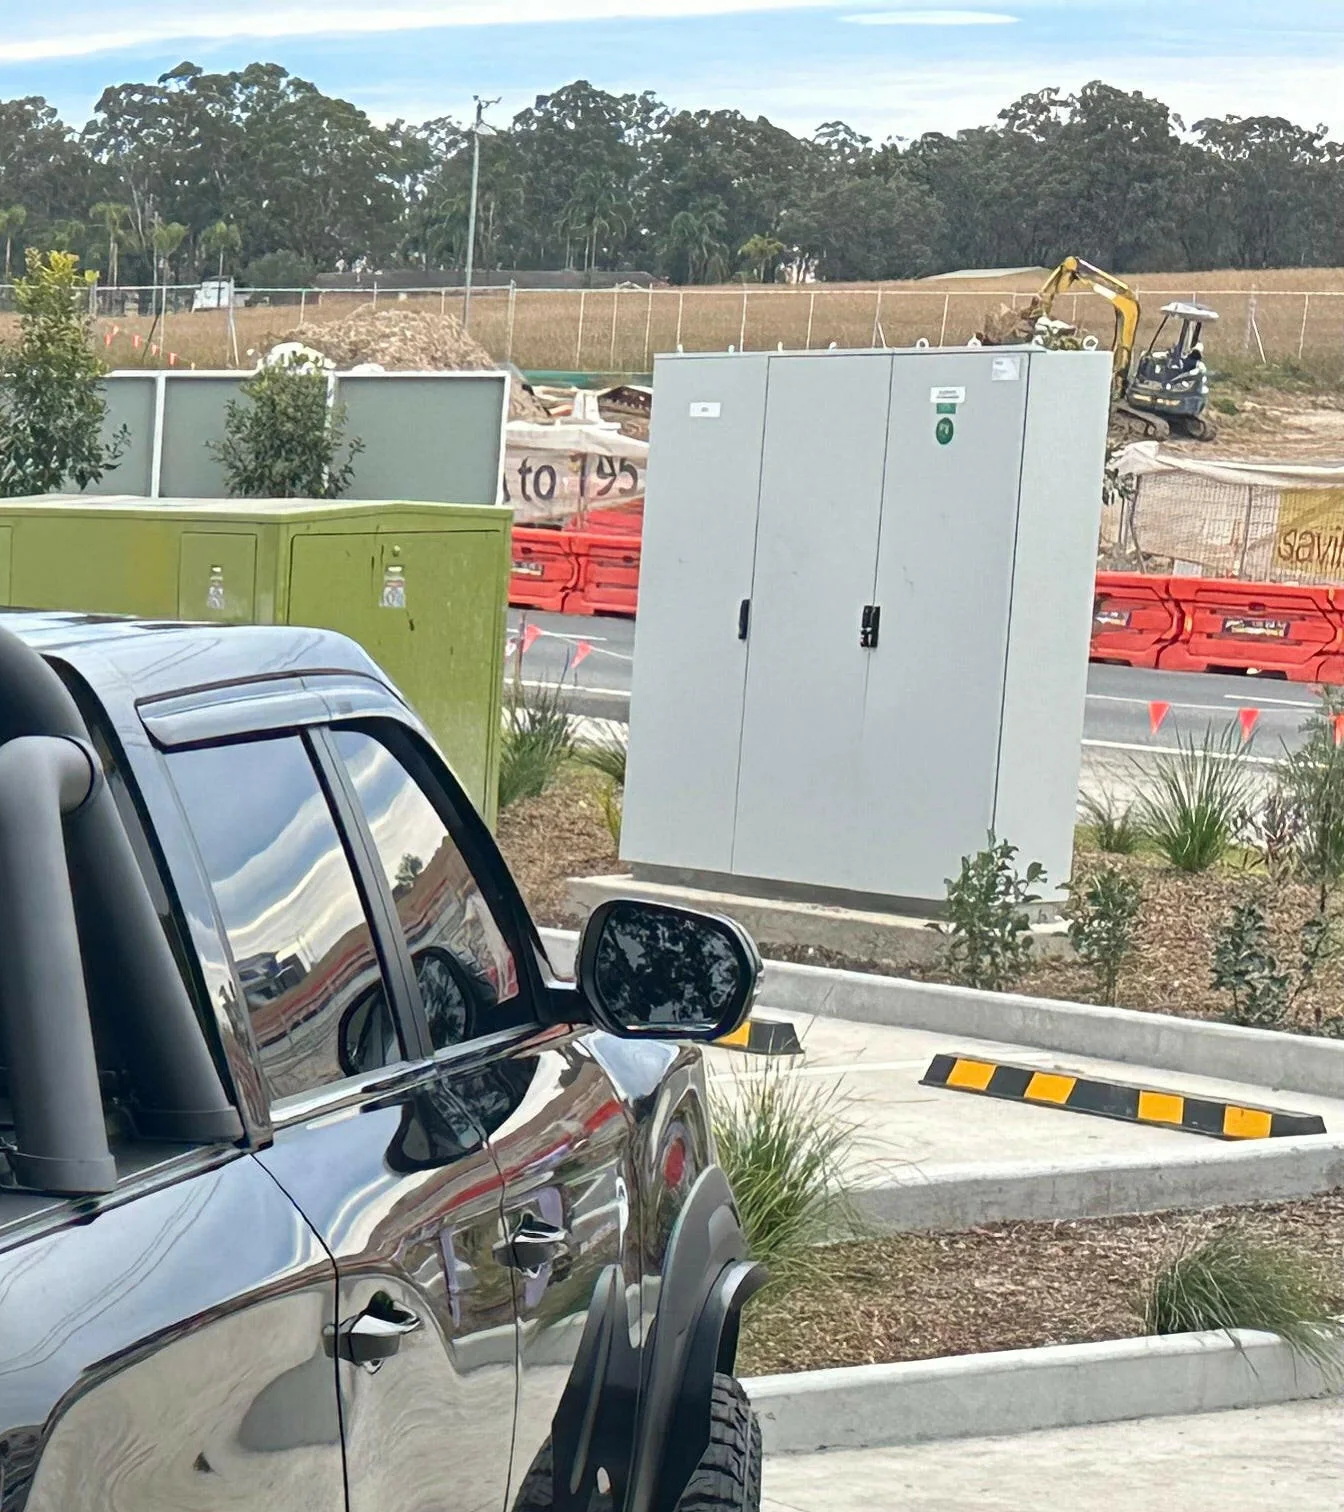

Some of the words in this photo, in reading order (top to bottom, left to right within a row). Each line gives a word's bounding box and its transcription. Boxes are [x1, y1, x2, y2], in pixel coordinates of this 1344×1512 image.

[518, 456, 557, 502] to
[569, 452, 639, 498] 195
[1277, 526, 1344, 569] savi
